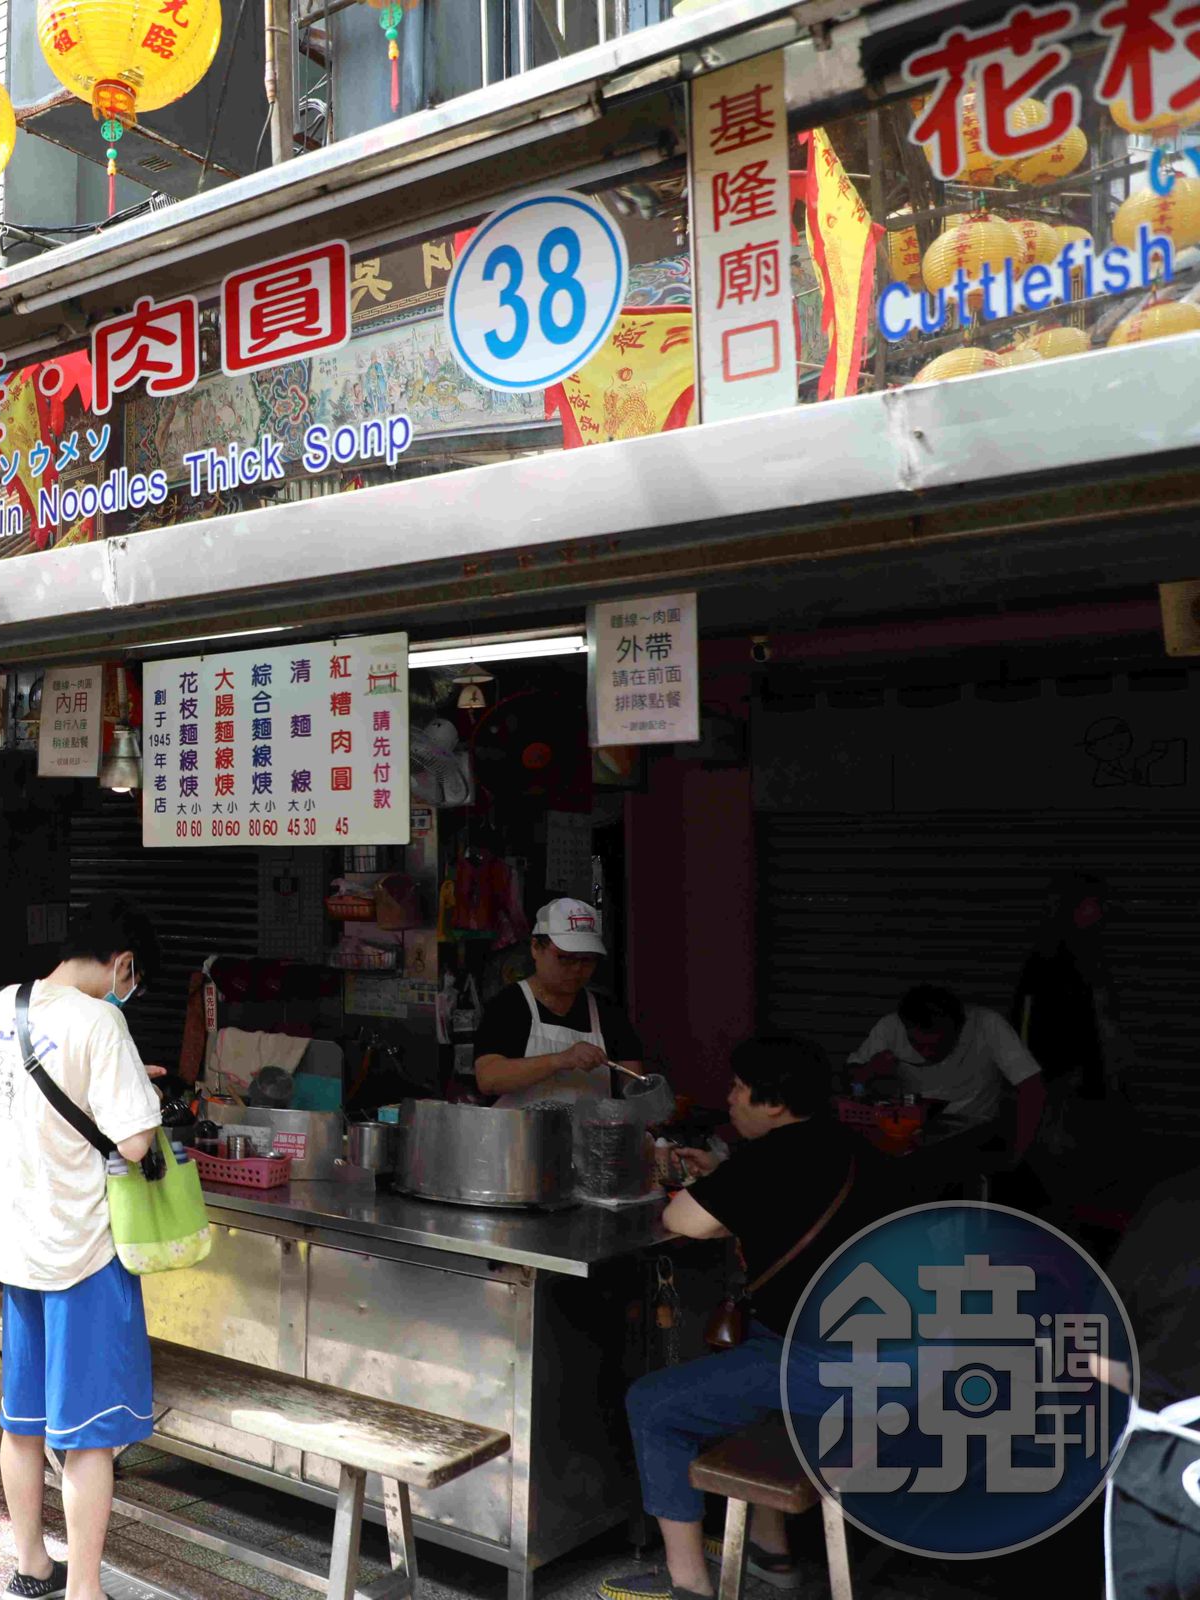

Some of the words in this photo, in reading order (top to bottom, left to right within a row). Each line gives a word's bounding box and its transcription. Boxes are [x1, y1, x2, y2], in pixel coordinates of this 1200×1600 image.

[707, 82, 786, 384] 基隆廟口
[481, 225, 588, 361] 38
[877, 222, 1175, 342] Cuttlefish
[39, 468, 167, 526] Noodles
[185, 436, 284, 498] Thick
[303, 417, 413, 472] Sonp
[616, 632, 672, 663] 外帶
[612, 665, 682, 687] 請在前面
[372, 710, 391, 810] 請先付款
[176, 821, 188, 837] 80
[191, 821, 202, 837] 60
[212, 820, 223, 837] 80
[225, 821, 240, 836] 60
[249, 820, 260, 836] 80
[263, 820, 278, 836] 60
[287, 818, 300, 836] 45
[304, 818, 316, 836] 30
[335, 817, 349, 836] 45
